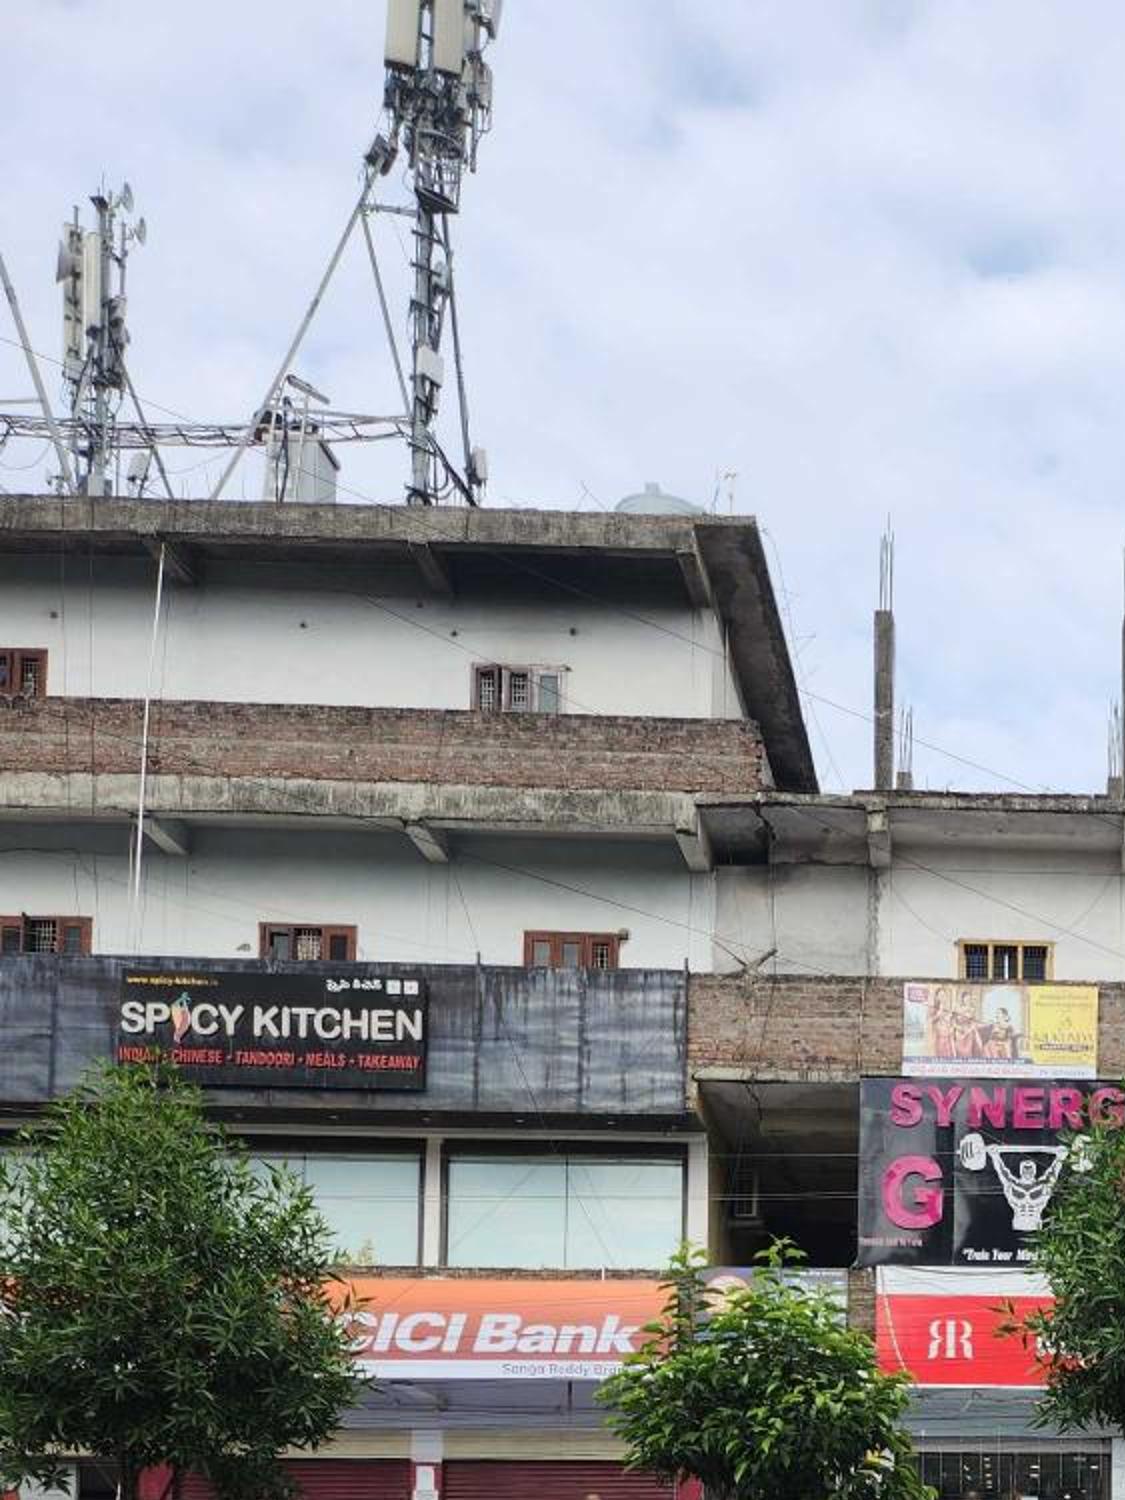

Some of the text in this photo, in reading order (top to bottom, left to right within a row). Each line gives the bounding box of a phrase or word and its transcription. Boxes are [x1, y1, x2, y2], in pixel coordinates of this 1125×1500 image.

[252, 1004, 424, 1042] KITCHEN
[171, 1049, 224, 1065] CHINESE
[234, 1051, 295, 1067] TANDOORI
[305, 1053, 346, 1069] MEALS
[358, 1054, 421, 1070] TAKEAWAY
[338, 1312, 642, 1354] CICI Bank
